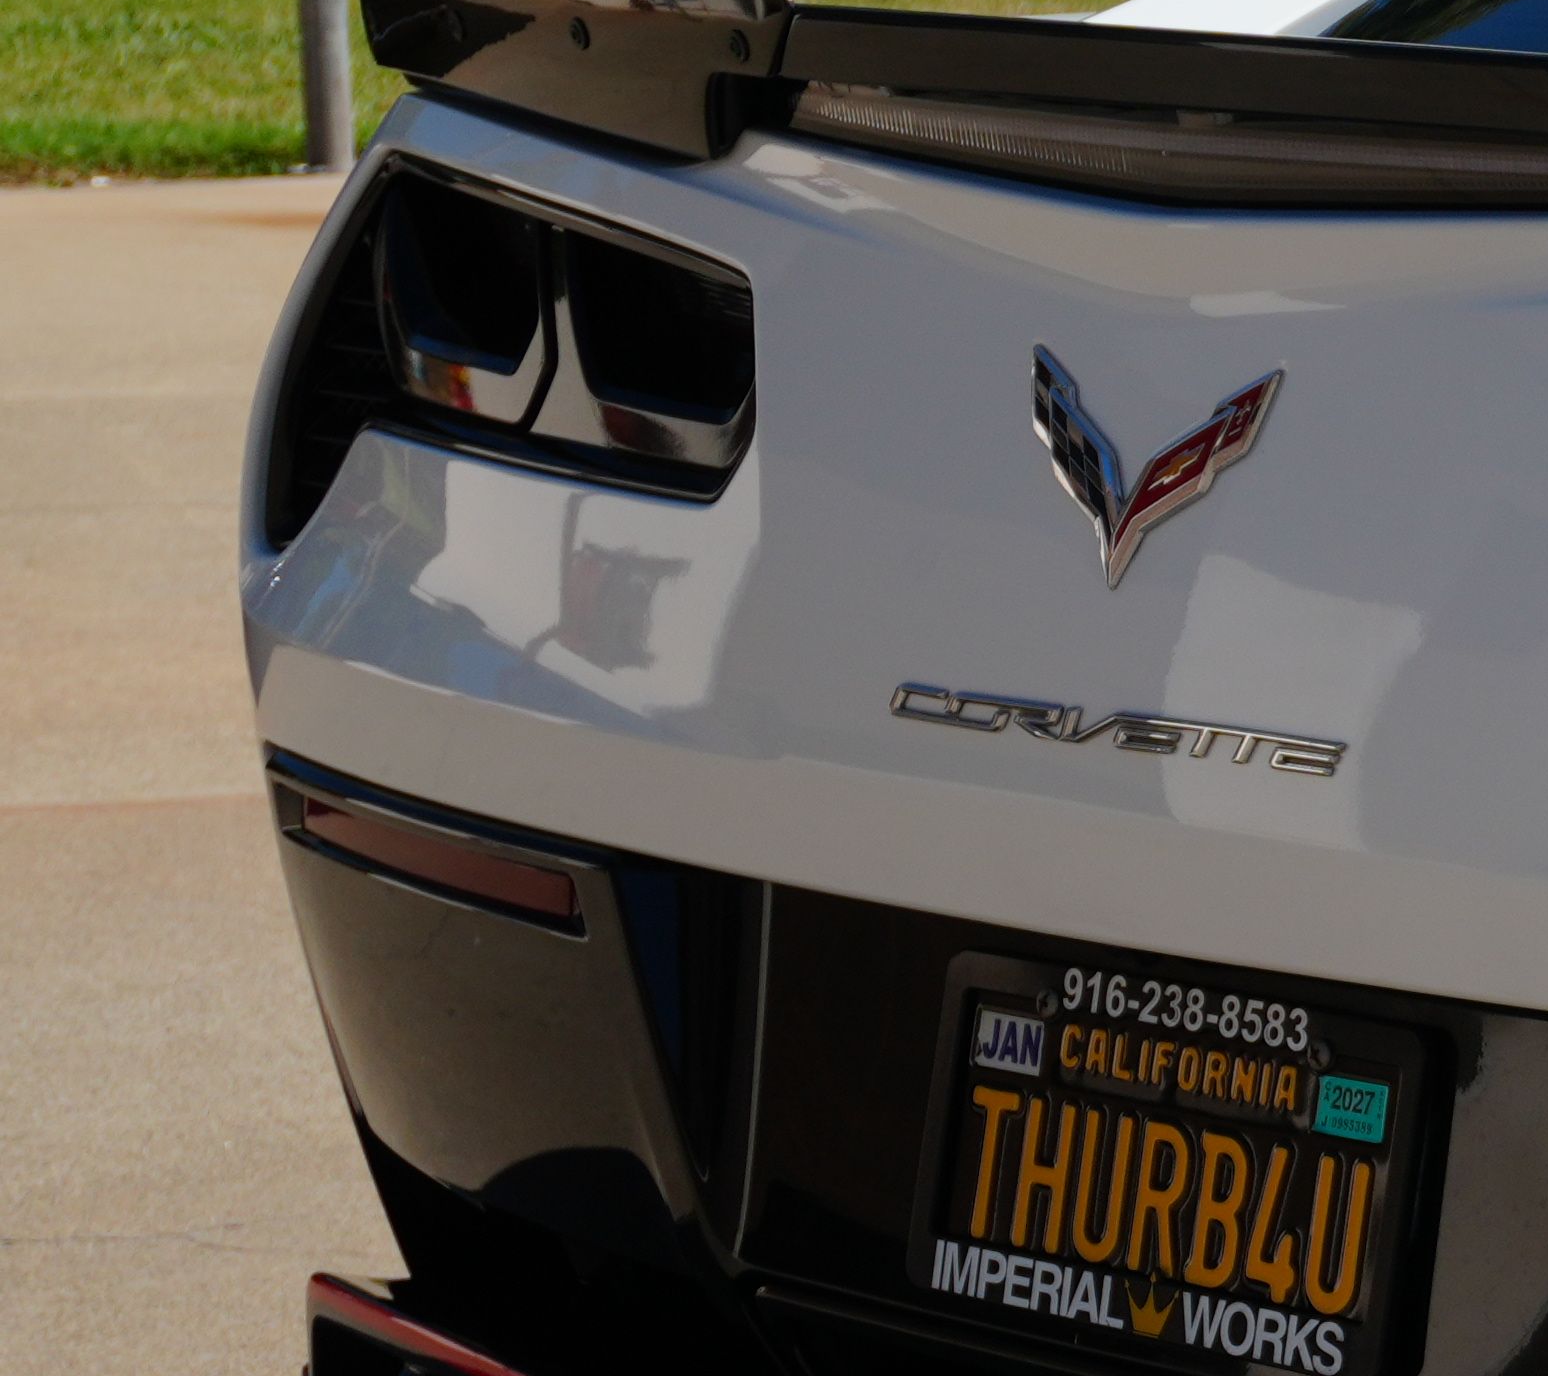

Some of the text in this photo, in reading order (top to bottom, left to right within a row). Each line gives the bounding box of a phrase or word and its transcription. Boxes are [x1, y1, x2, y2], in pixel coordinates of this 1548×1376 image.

[889, 682, 1348, 777] CORVETTE
[983, 1018, 1043, 1068] JAN
[1062, 966, 1309, 1052] 916-238-8583
[1059, 1023, 1297, 1112] CALIFORNIA
[1332, 1086, 1375, 1115] 2027
[971, 1086, 1371, 1315] THURB4U
[931, 1238, 1345, 1376] IMPERIAL WORKS
